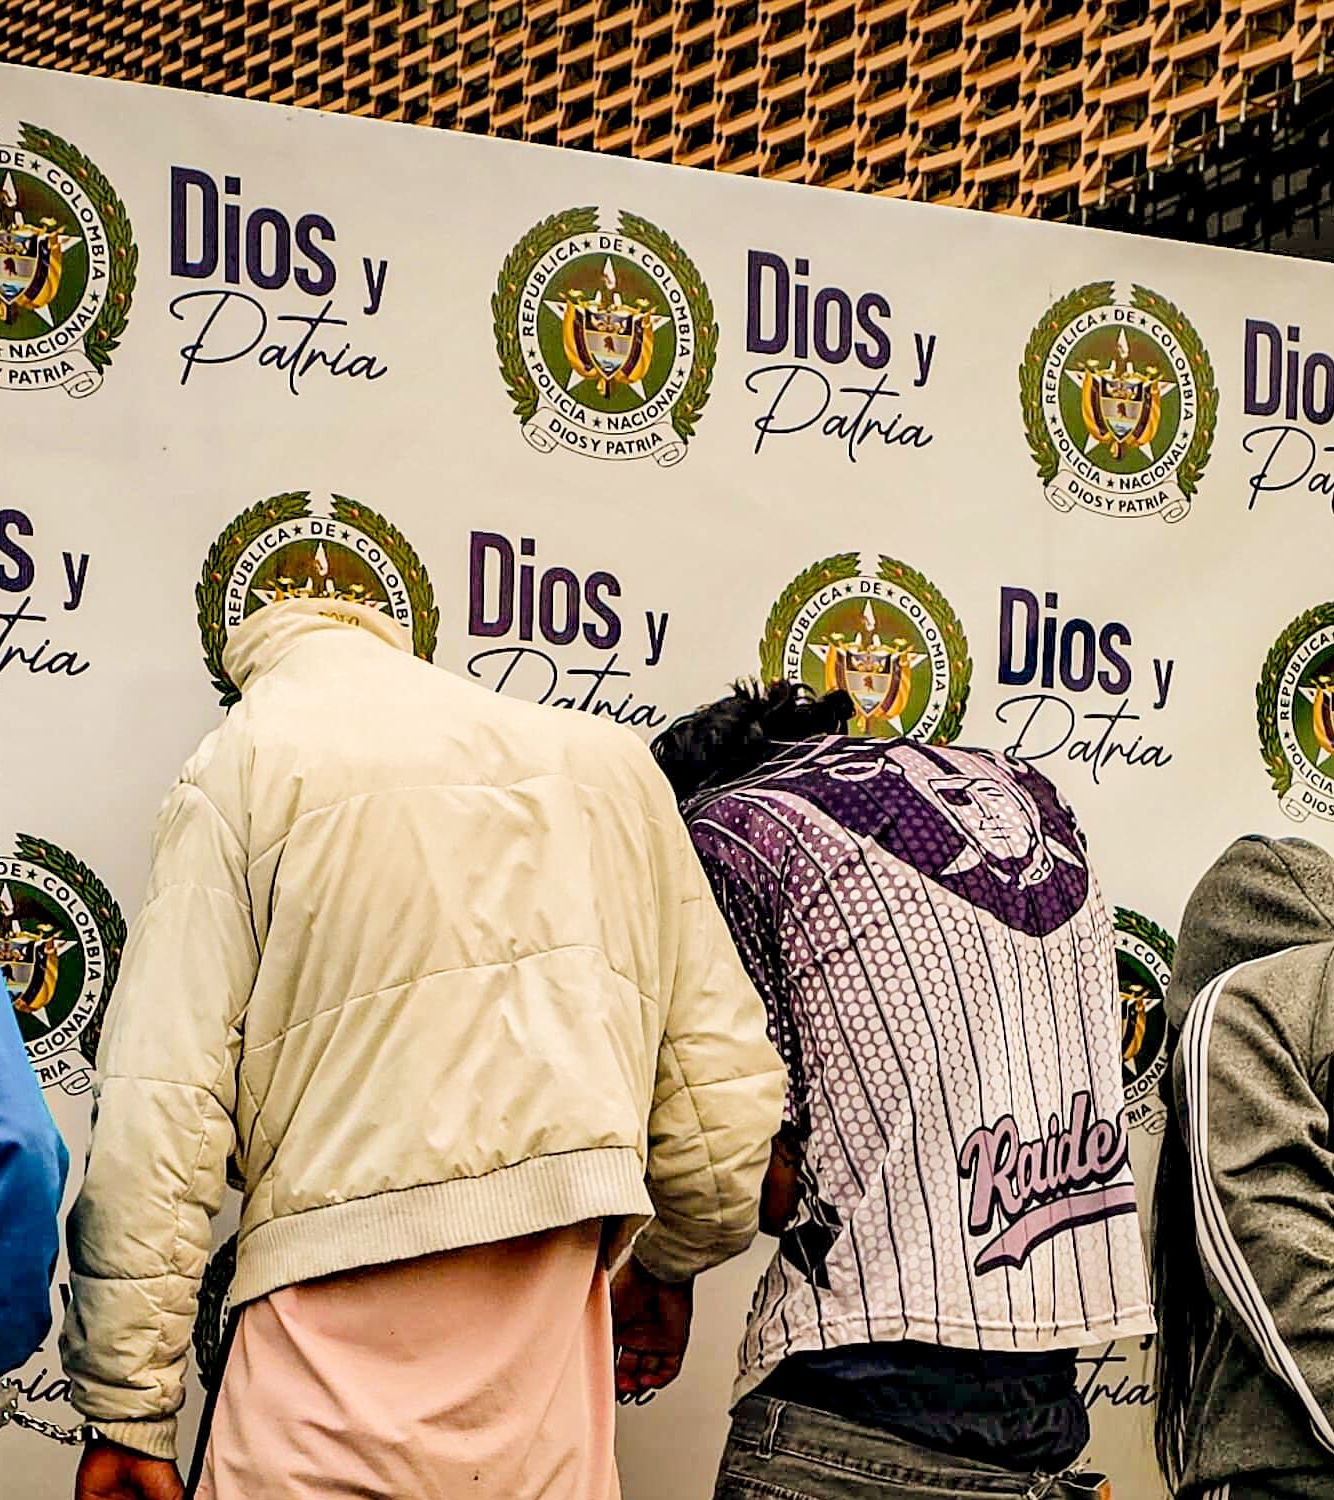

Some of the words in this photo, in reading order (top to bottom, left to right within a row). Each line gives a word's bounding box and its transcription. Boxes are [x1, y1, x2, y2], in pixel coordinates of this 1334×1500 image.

[46, 169, 106, 281] COLOMBIA
[171, 166, 336, 296] Dios
[363, 258, 387, 315] y
[9, 306, 97, 359] NACIONAL
[170, 291, 387, 395] Patria
[599, 236, 624, 253] DE
[641, 253, 691, 358] COLOMBIA
[747, 250, 891, 369] Dios
[914, 334, 936, 387] y
[1114, 309, 1136, 324] DE
[8, 360, 75, 384] PATRIA
[607, 381, 683, 431] NACIONAL
[746, 365, 932, 462] Patria
[63, 552, 89, 610] y
[310, 521, 337, 538] DE
[469, 531, 621, 649] Dios
[646, 612, 668, 666] y
[860, 581, 883, 595] DE
[899, 595, 946, 692] COLOMBIA
[998, 587, 1131, 695] Dios
[1153, 659, 1173, 709] y
[42, 876, 101, 982] COLOMBIA
